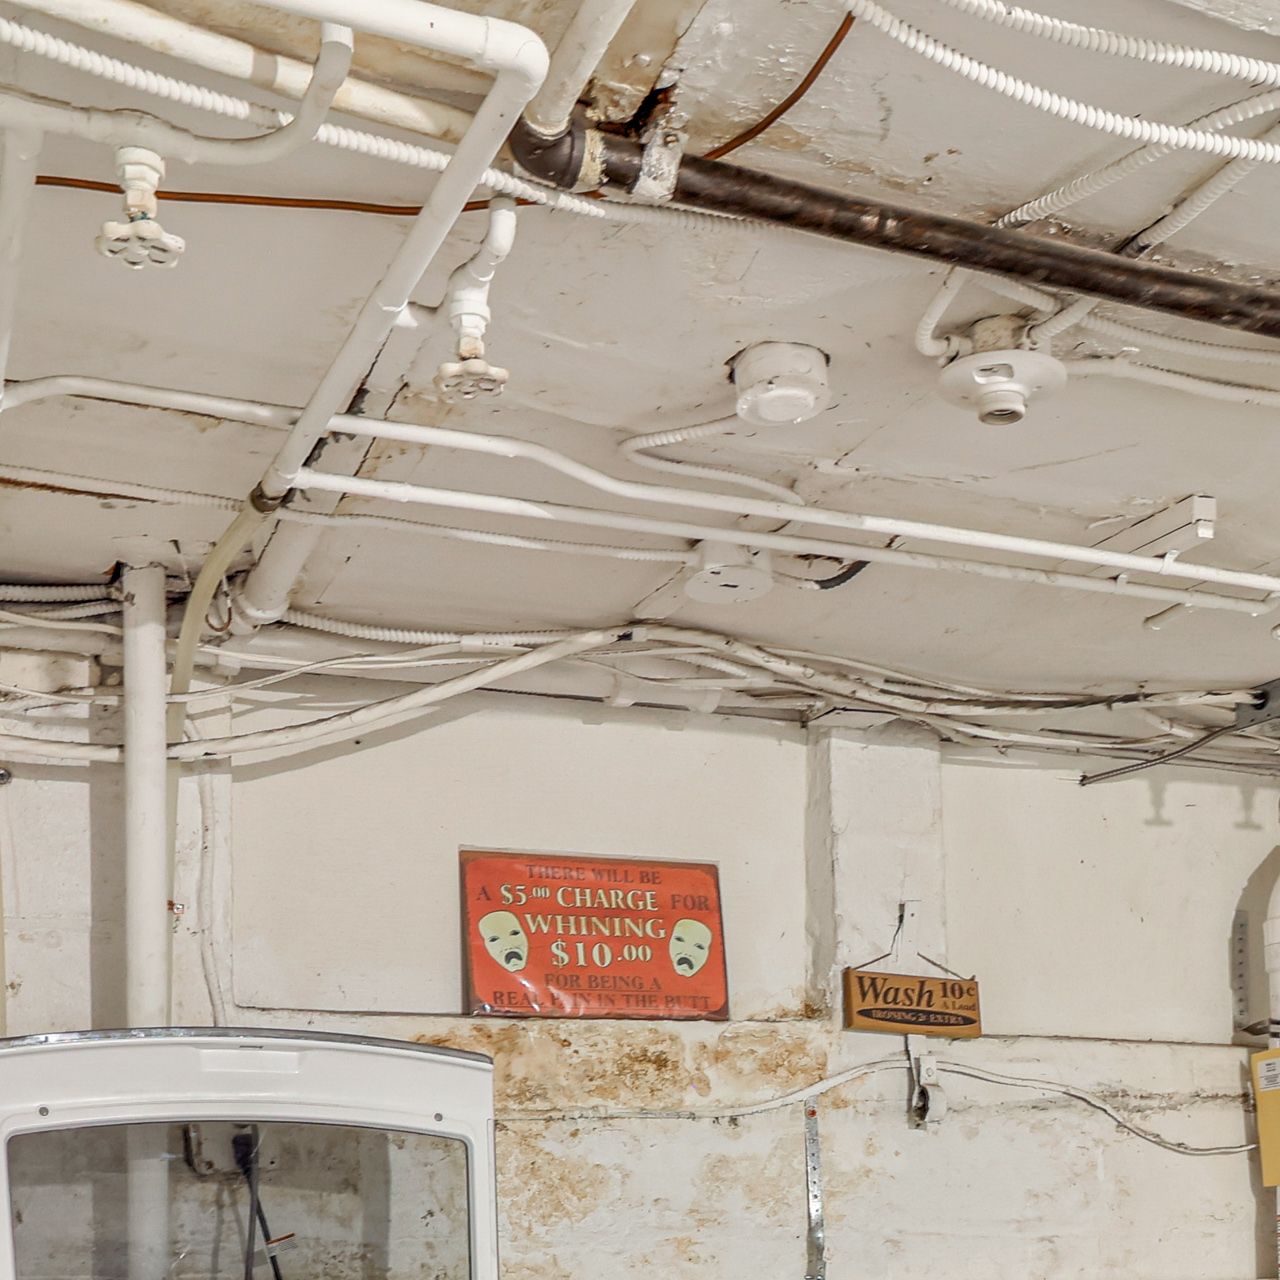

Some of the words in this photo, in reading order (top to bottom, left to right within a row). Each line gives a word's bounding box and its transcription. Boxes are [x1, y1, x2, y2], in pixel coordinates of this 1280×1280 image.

[526, 864, 586, 881] THERE
[592, 867, 635, 884] WILL
[640, 870, 662, 885] BE
[476, 886, 492, 902] A
[499, 883, 551, 906] $5.00
[556, 886, 659, 912] CHARGE
[670, 894, 710, 912] FOR
[523, 913, 667, 939] WHINING
[550, 938, 653, 969] $10.00
[544, 973, 581, 989] FOR
[587, 974, 645, 991] BEING
[650, 976, 661, 990] A
[856, 976, 936, 1008] Wash
[493, 991, 544, 1006] REAL
[550, 992, 592, 1008] PIN
[597, 993, 616, 1007] IN
[622, 994, 658, 1008] THE
[663, 995, 711, 1010] BUTT
